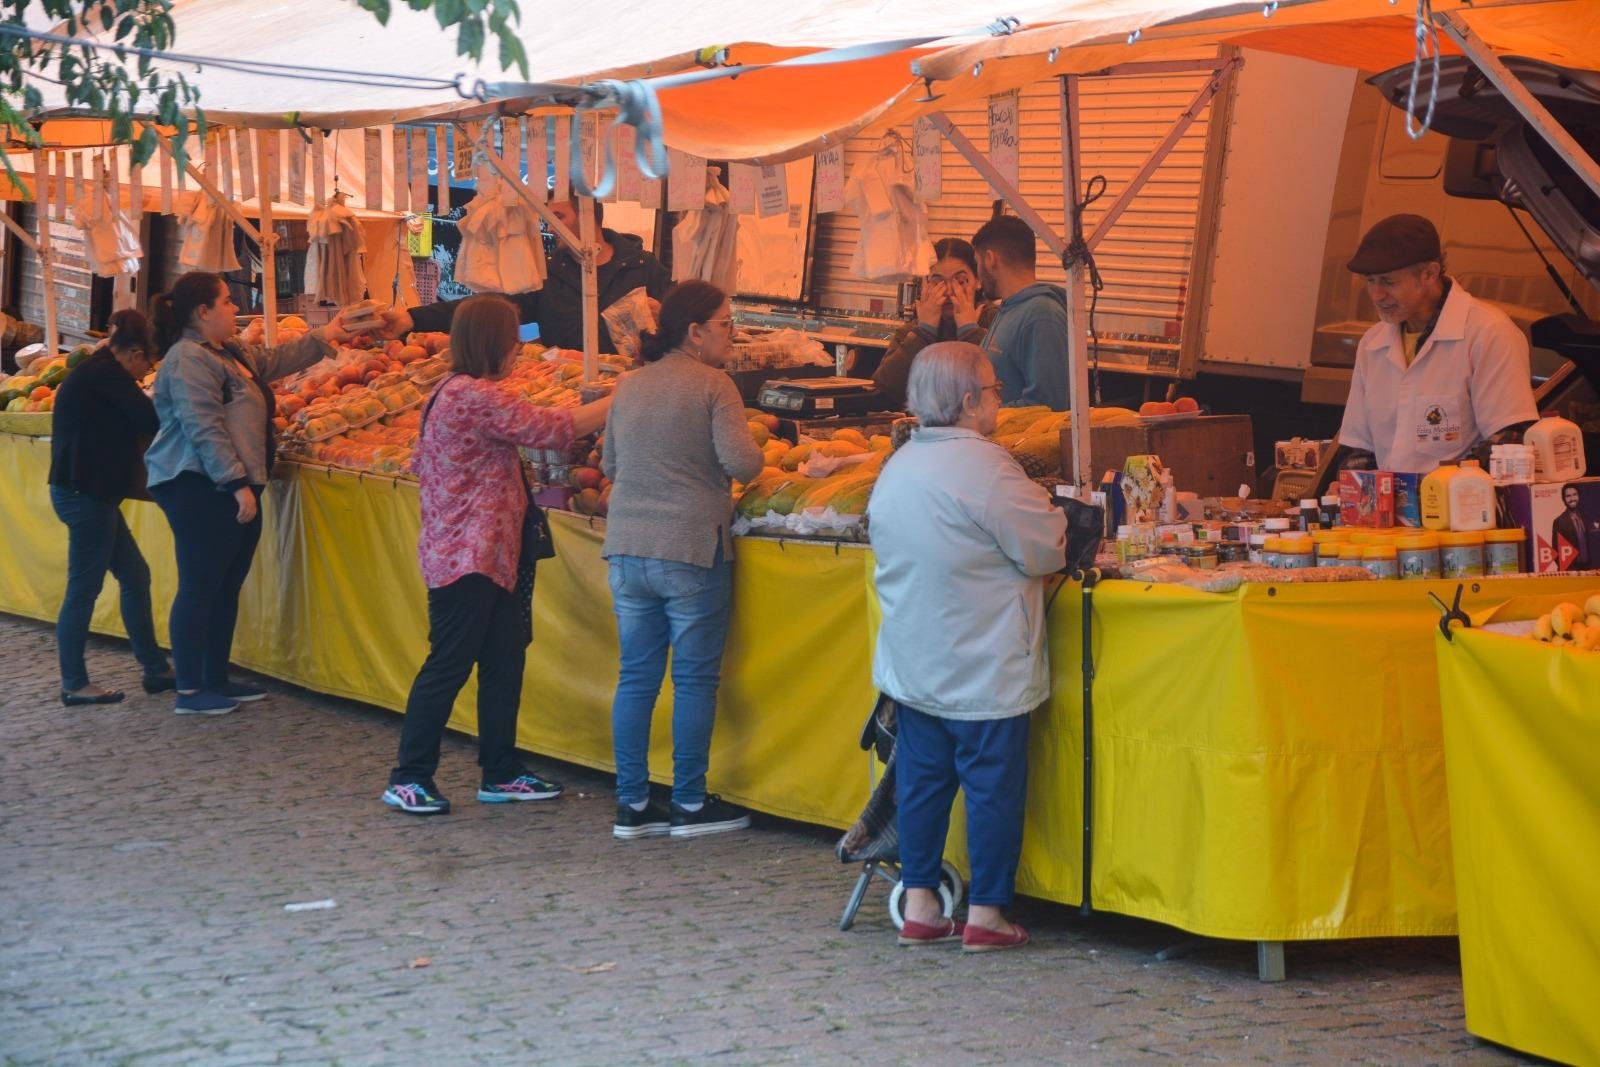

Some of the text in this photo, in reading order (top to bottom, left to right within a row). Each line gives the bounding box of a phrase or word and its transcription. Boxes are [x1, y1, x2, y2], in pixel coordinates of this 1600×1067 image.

[458, 151, 472, 170] 219
[1540, 547, 1573, 563] B P
